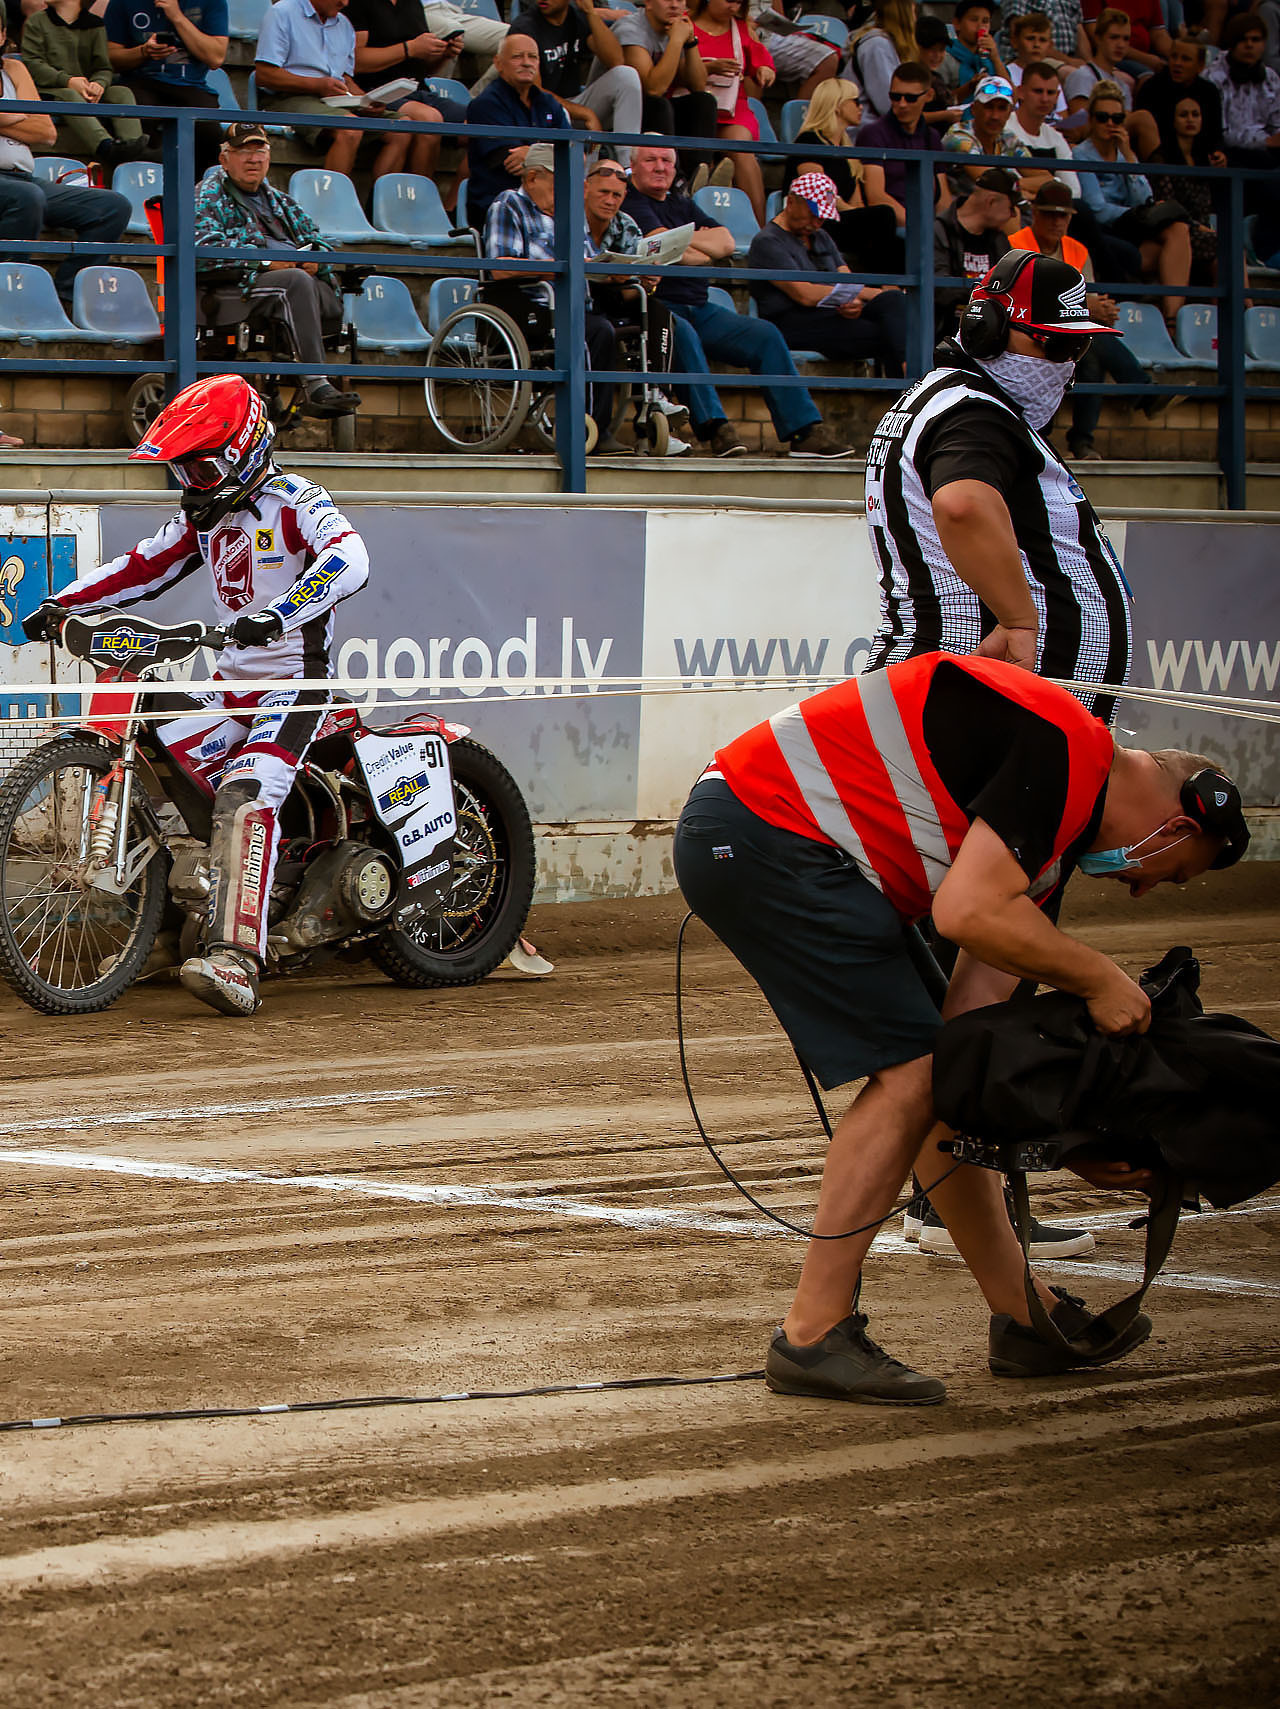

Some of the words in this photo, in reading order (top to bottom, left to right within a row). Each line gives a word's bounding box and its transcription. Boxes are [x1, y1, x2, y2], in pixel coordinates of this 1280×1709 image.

[137, 168, 156, 187] 15
[314, 175, 332, 196] 17
[713, 191, 731, 207] 22
[97, 276, 118, 294] 13
[366, 284, 384, 301] 16
[452, 284, 471, 304] 17
[289, 569, 337, 608] REALL
[101, 636, 144, 650] REALL
[419, 740, 445, 769] #91
[388, 779, 423, 805] REALL
[402, 828, 424, 847] G.B.
[424, 811, 453, 837] AUTO
